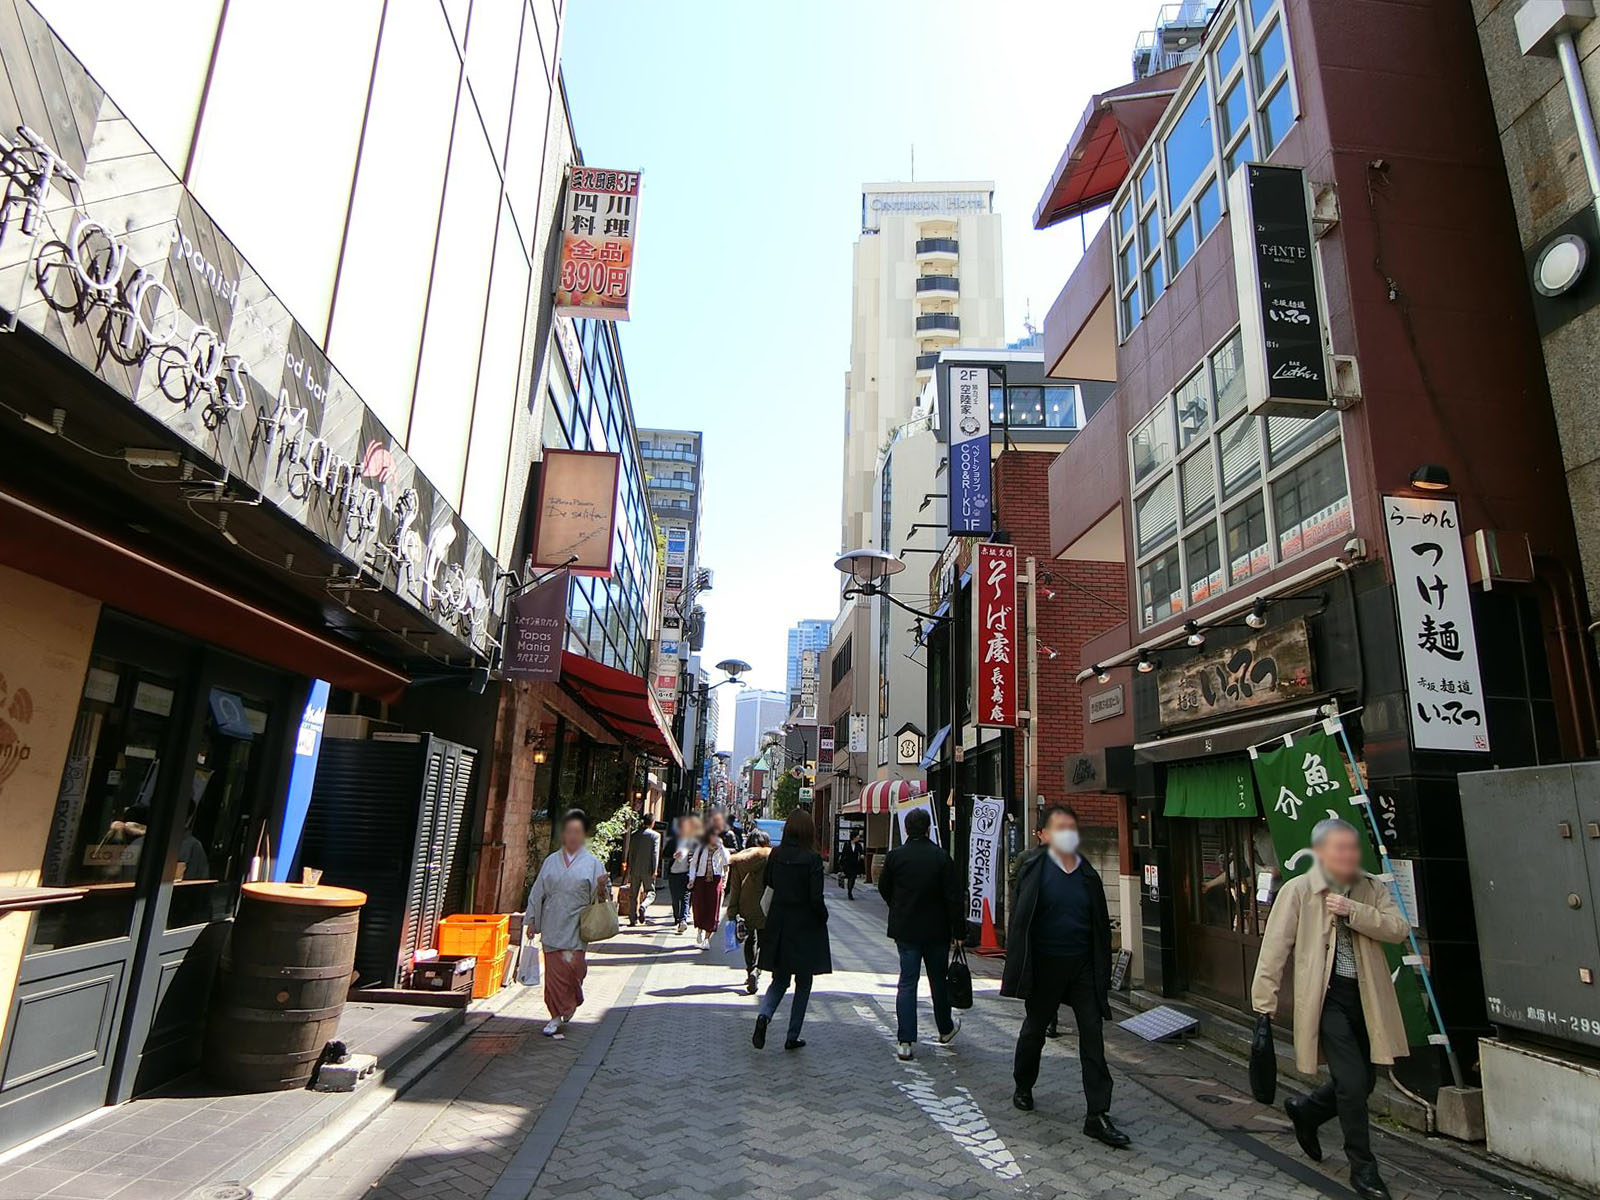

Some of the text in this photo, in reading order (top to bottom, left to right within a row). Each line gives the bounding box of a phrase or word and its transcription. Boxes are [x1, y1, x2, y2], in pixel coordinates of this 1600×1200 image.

[573, 193, 631, 216] 四川
[571, 215, 630, 238] 料理
[571, 240, 624, 262] 全品
[1260, 244, 1307, 258] TANTE
[562, 260, 627, 296] 390円
[1269, 309, 1310, 325] いってつ
[305, 365, 327, 402] bar
[960, 369, 978, 381] 2F
[960, 384, 971, 415] 空陸家
[961, 443, 972, 517] COO&RIKU
[971, 444, 981, 492] ペットショップ
[963, 519, 980, 531] 1F
[1390, 505, 1456, 529] らーめん
[1411, 542, 1464, 662] つけ麺
[517, 641, 551, 652] Mania
[519, 629, 552, 641] Tapas
[1200, 648, 1278, 706] いってつ
[1417, 701, 1481, 726] いってつ
[1237, 775, 1246, 810] いってつ
[1379, 795, 1398, 839] いってつ
[984, 839, 992, 883] MONEY
[970, 837, 985, 919] EXCHANGE
